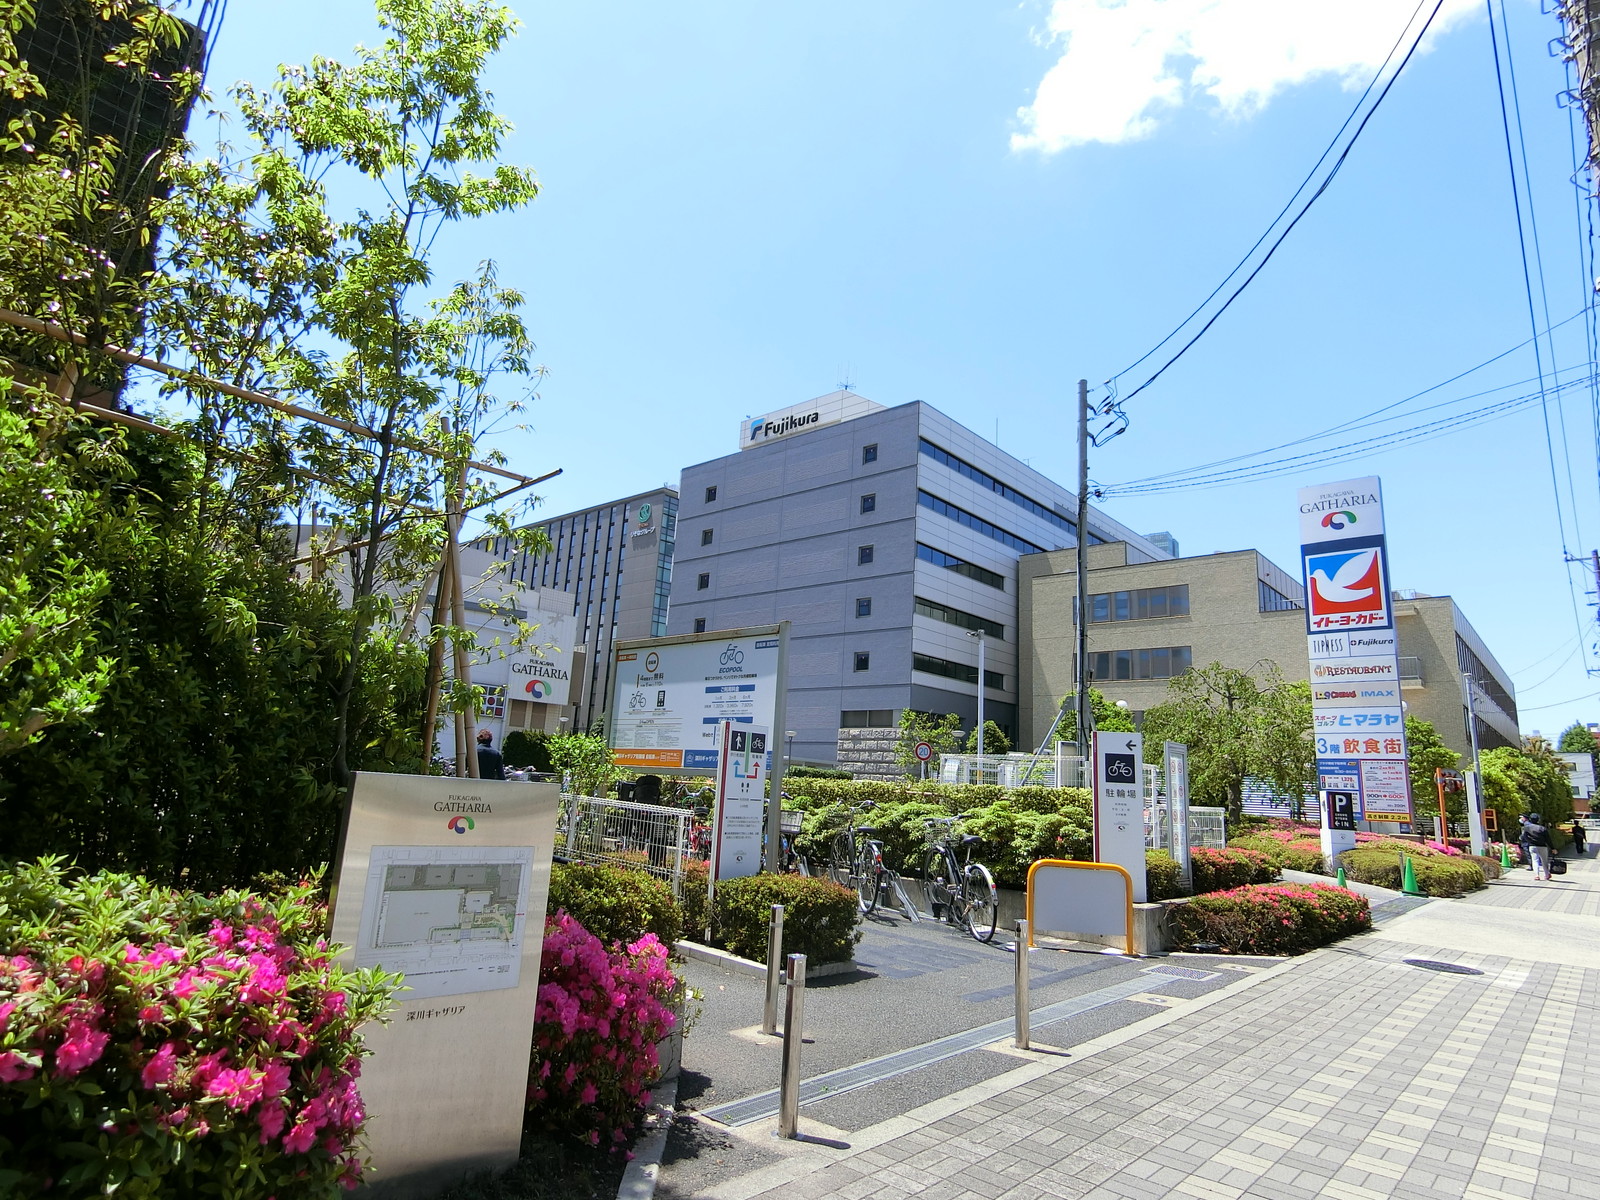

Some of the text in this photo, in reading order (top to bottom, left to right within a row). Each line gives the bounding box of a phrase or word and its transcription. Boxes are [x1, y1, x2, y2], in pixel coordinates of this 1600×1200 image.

[764, 412, 819, 437] Fujikura
[1320, 489, 1354, 500] FUKAGAWA
[1300, 494, 1378, 514] GATHARIA
[1313, 613, 1384, 628] イトーヨーカドー
[1313, 637, 1343, 654] TIPNESS
[1358, 639, 1394, 647] Fujikura
[512, 662, 569, 681] GATHARIA
[718, 666, 743, 674] ECOPOOL
[1361, 690, 1395, 698] IMAX
[1338, 714, 1400, 727] ヒマラヤ
[918, 747, 929, 756] 20
[1343, 738, 1402, 755] 飲食街
[448, 794, 482, 802] FUKAGAWA
[1105, 788, 1137, 799] 駐輪場
[433, 801, 492, 813] GATHARIA
[1335, 794, 1347, 813] P
[1341, 820, 1349, 828] IN
[406, 1005, 466, 1022] 深川ギャザリア
